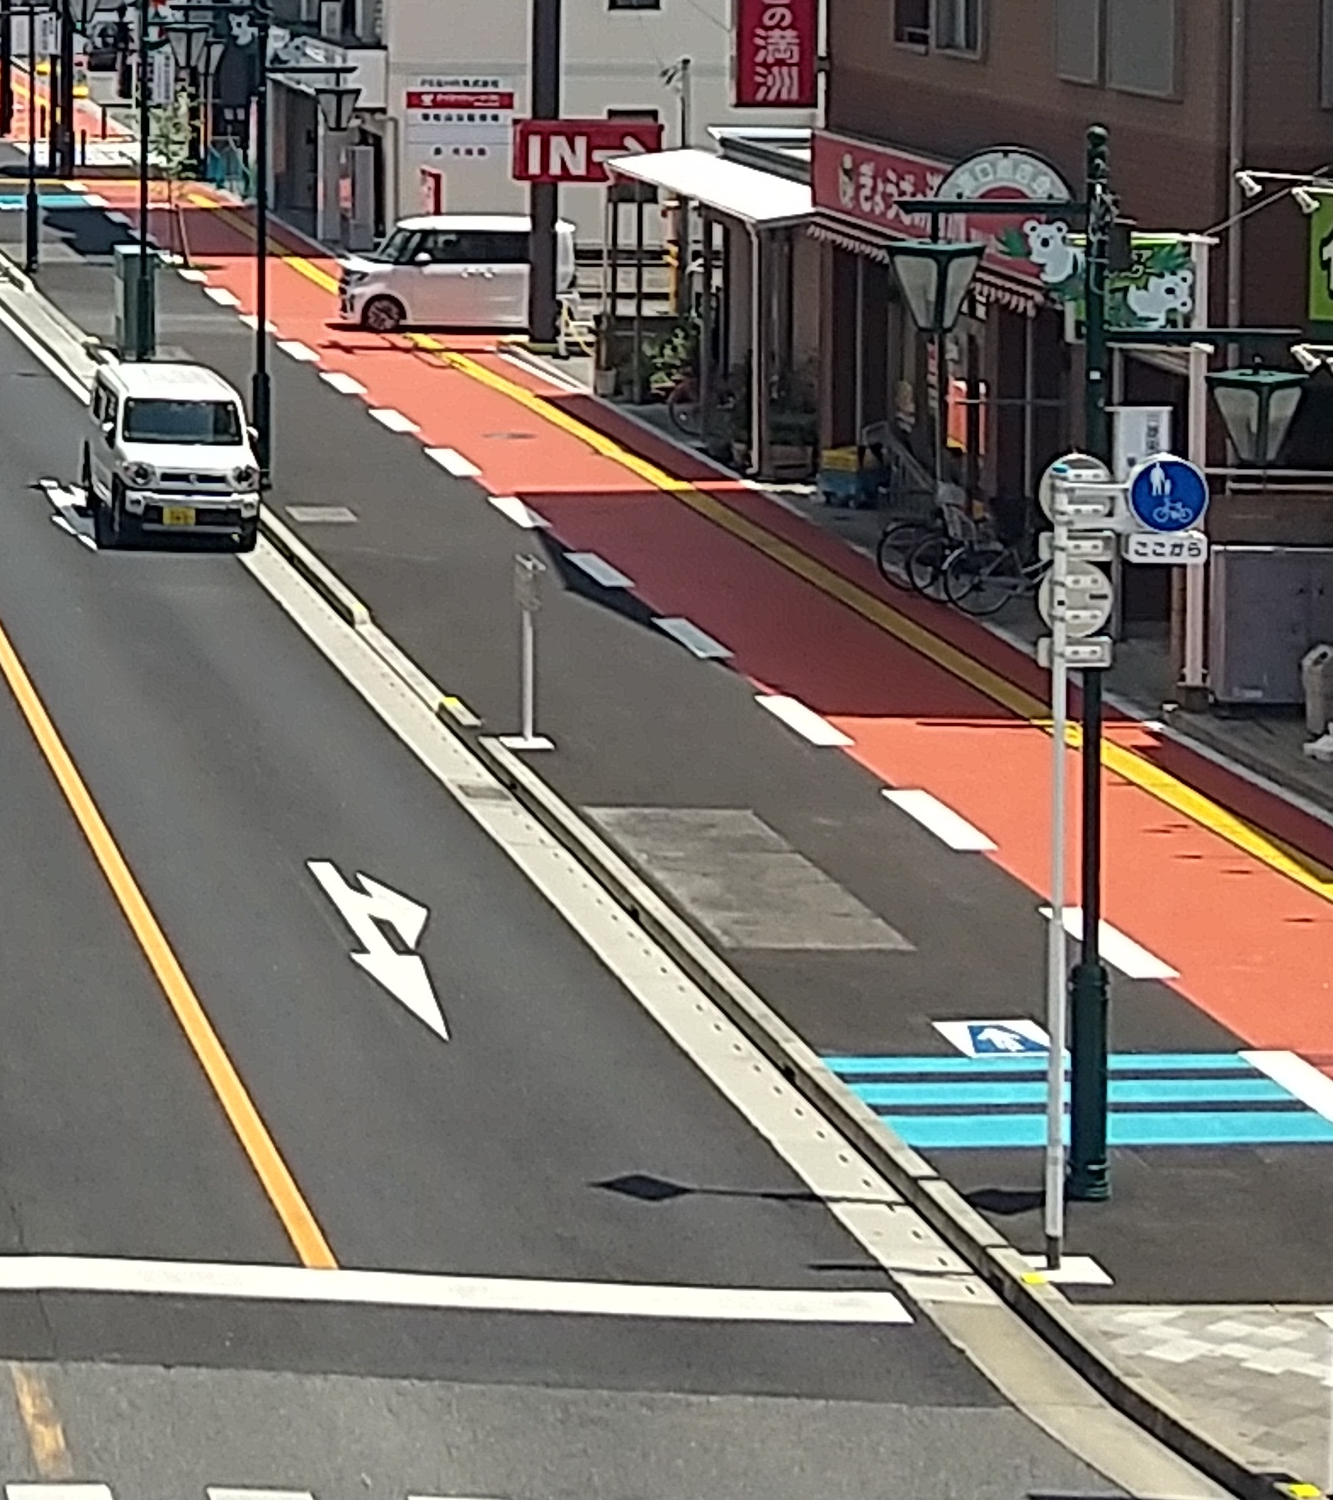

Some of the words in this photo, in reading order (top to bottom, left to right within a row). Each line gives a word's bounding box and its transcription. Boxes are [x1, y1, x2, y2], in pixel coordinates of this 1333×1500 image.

[527, 134, 588, 177] IN
[1134, 541, 1202, 558] ここから
